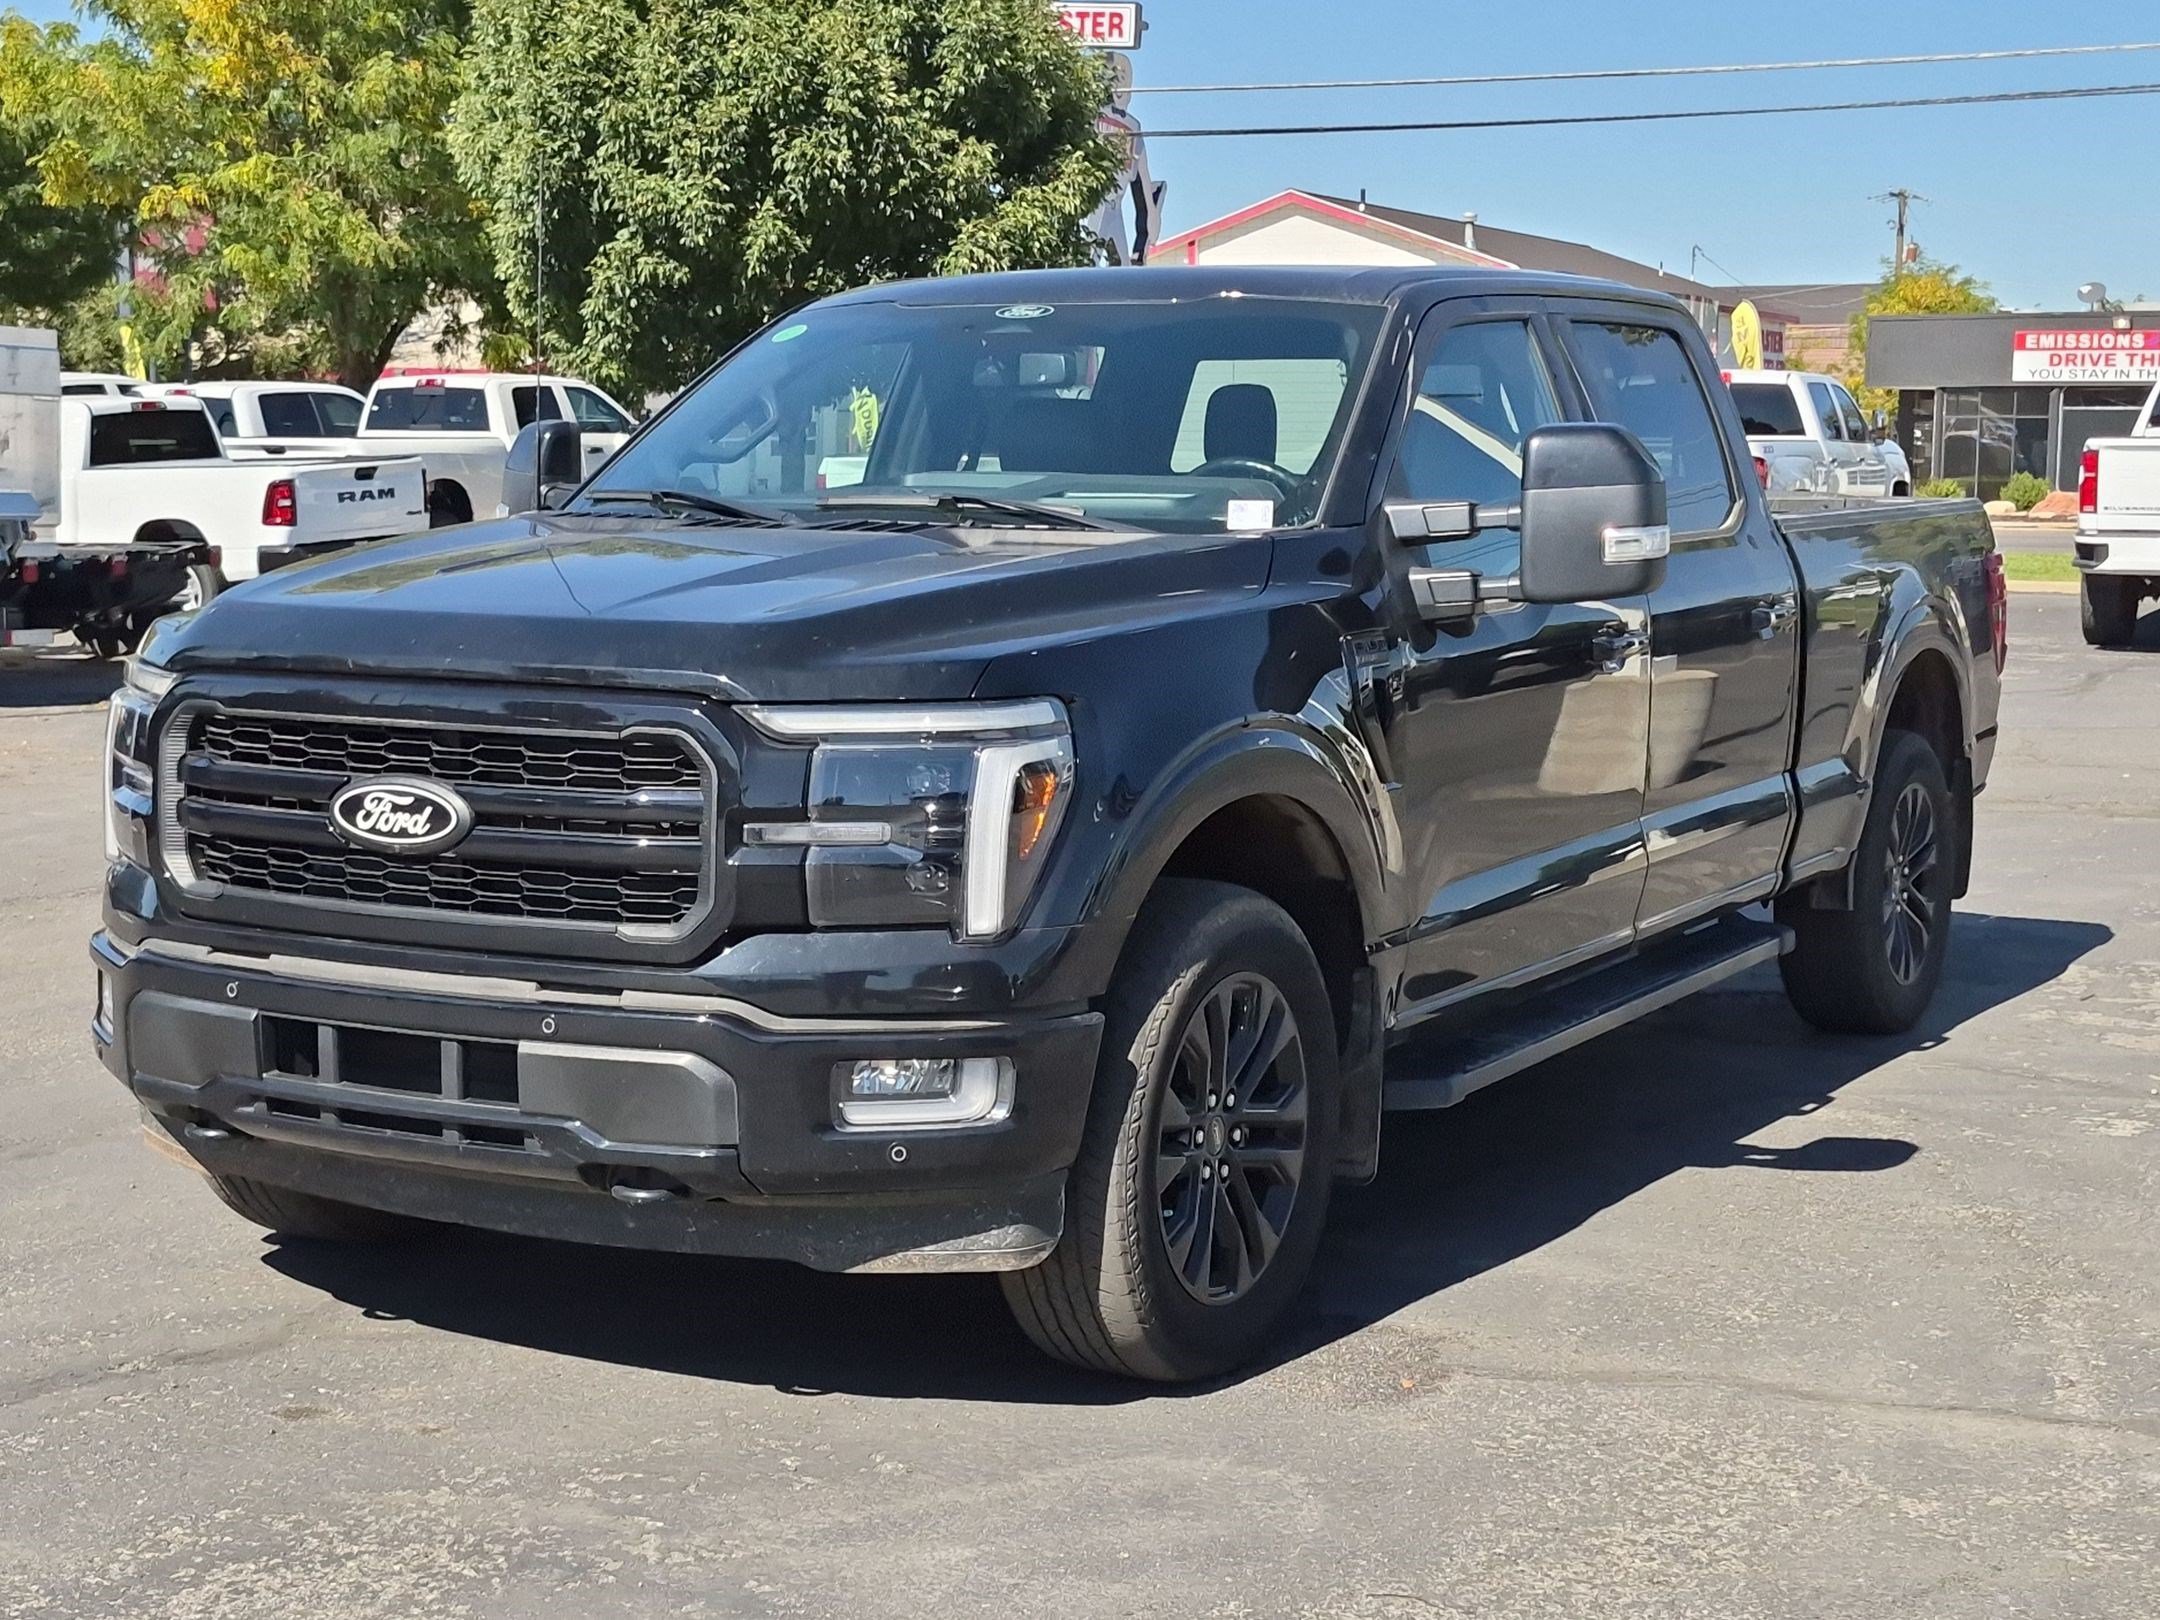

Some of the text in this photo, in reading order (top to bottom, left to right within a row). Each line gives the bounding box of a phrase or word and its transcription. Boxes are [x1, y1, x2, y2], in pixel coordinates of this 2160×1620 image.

[2024, 333, 2145, 349] EMISSIONS
[2049, 353, 2160, 367] DRIVE TH
[2029, 369, 2063, 379] YOU
[2068, 369, 2109, 379] STAY
[2115, 369, 2130, 379] IN
[337, 487, 396, 503] RAM
[356, 791, 433, 835] Ford
